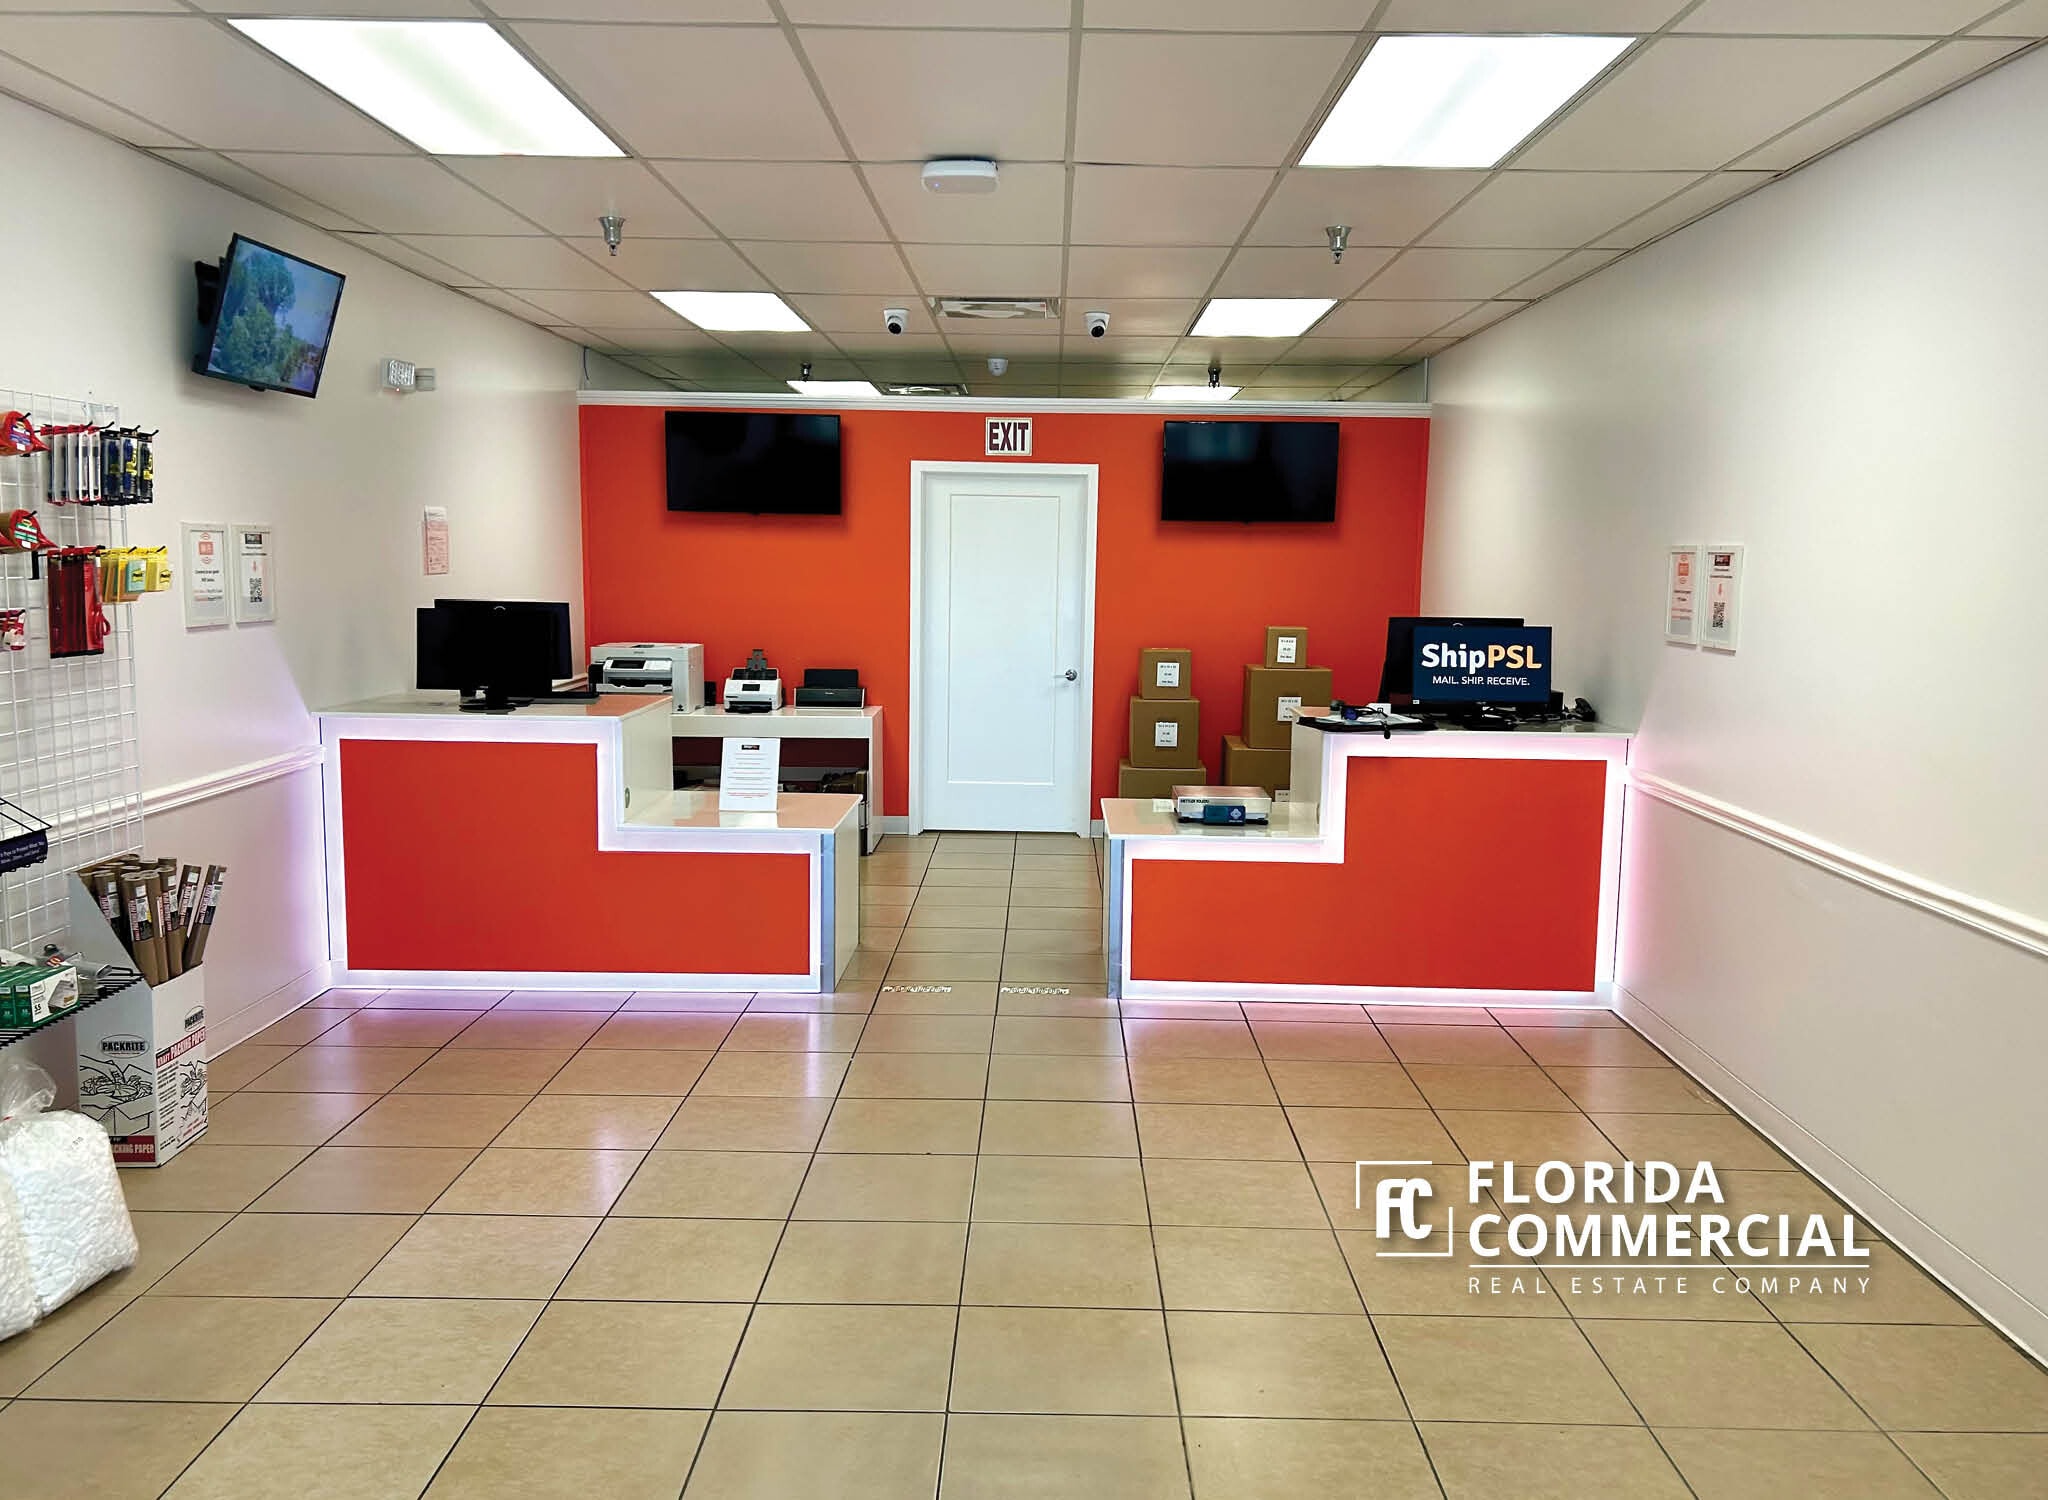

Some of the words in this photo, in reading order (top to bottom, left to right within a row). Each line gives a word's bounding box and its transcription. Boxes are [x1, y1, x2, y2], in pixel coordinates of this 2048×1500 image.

[989, 421, 1029, 451] EXIT
[1421, 642, 1542, 675] ShipPSL
[1432, 675, 1459, 685] MAIL.
[1461, 676, 1485, 685] SHIP.
[1486, 677, 1531, 686] RECEIVE.
[102, 1041, 146, 1052] PACKRITE
